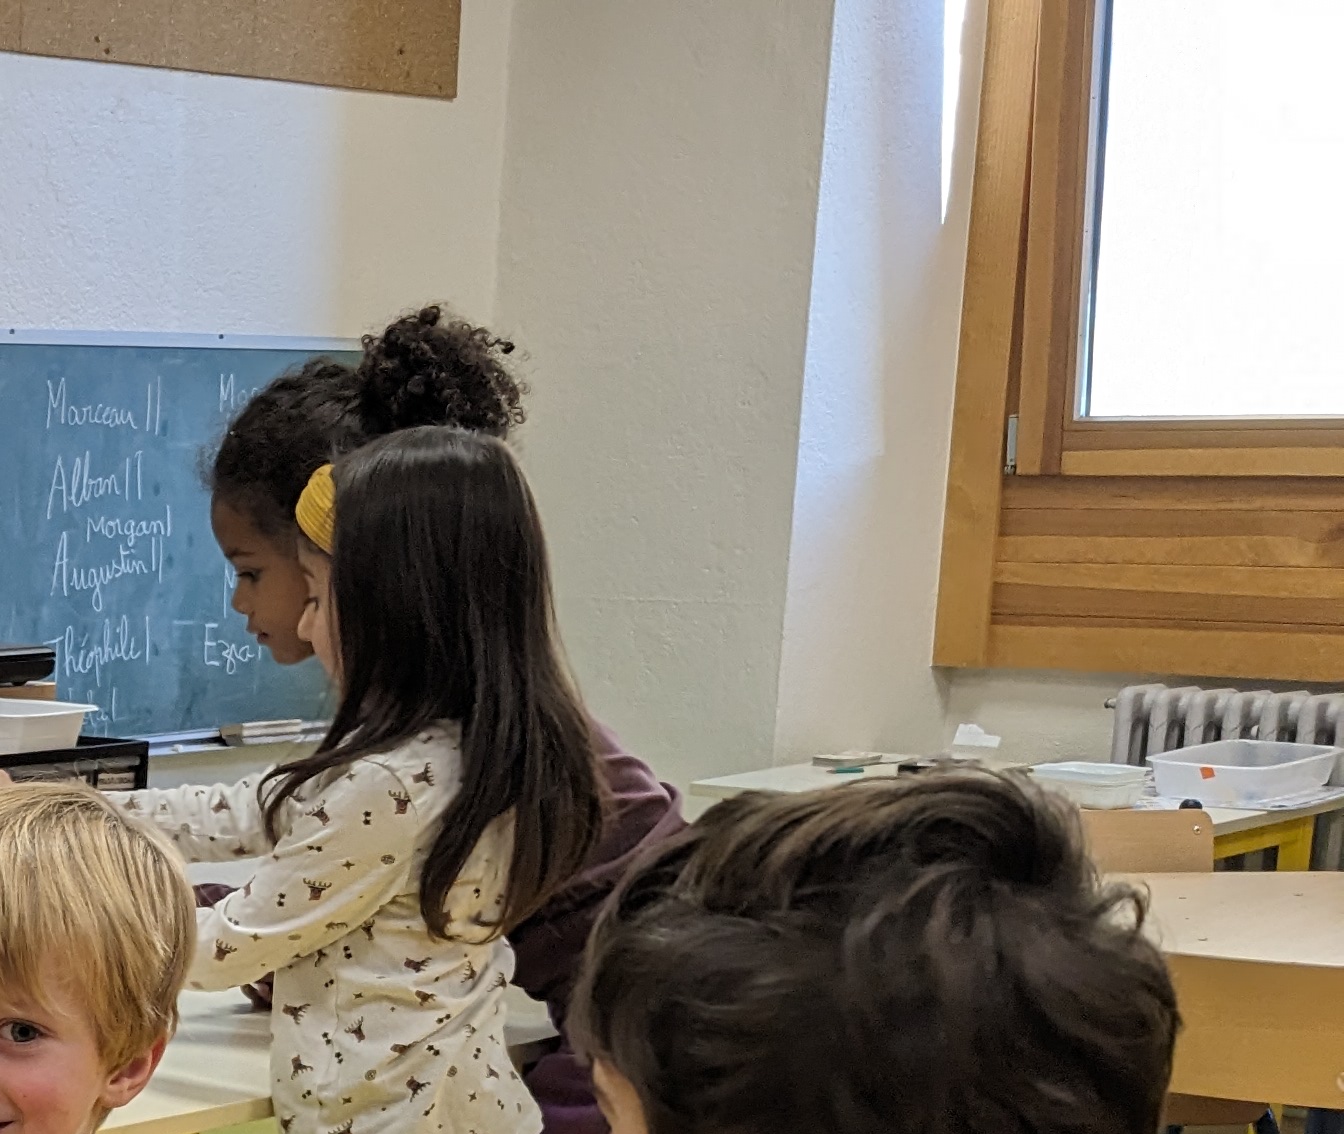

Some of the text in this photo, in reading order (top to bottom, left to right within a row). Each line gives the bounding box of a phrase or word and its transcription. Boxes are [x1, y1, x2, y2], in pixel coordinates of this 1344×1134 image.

[46, 377, 138, 430] Marceau
[46, 450, 120, 520] Alban
[86, 516, 165, 547] Morgan
[50, 531, 148, 612] Augustin
[43, 614, 142, 688] Théophile
[204, 623, 255, 674] Ezra
